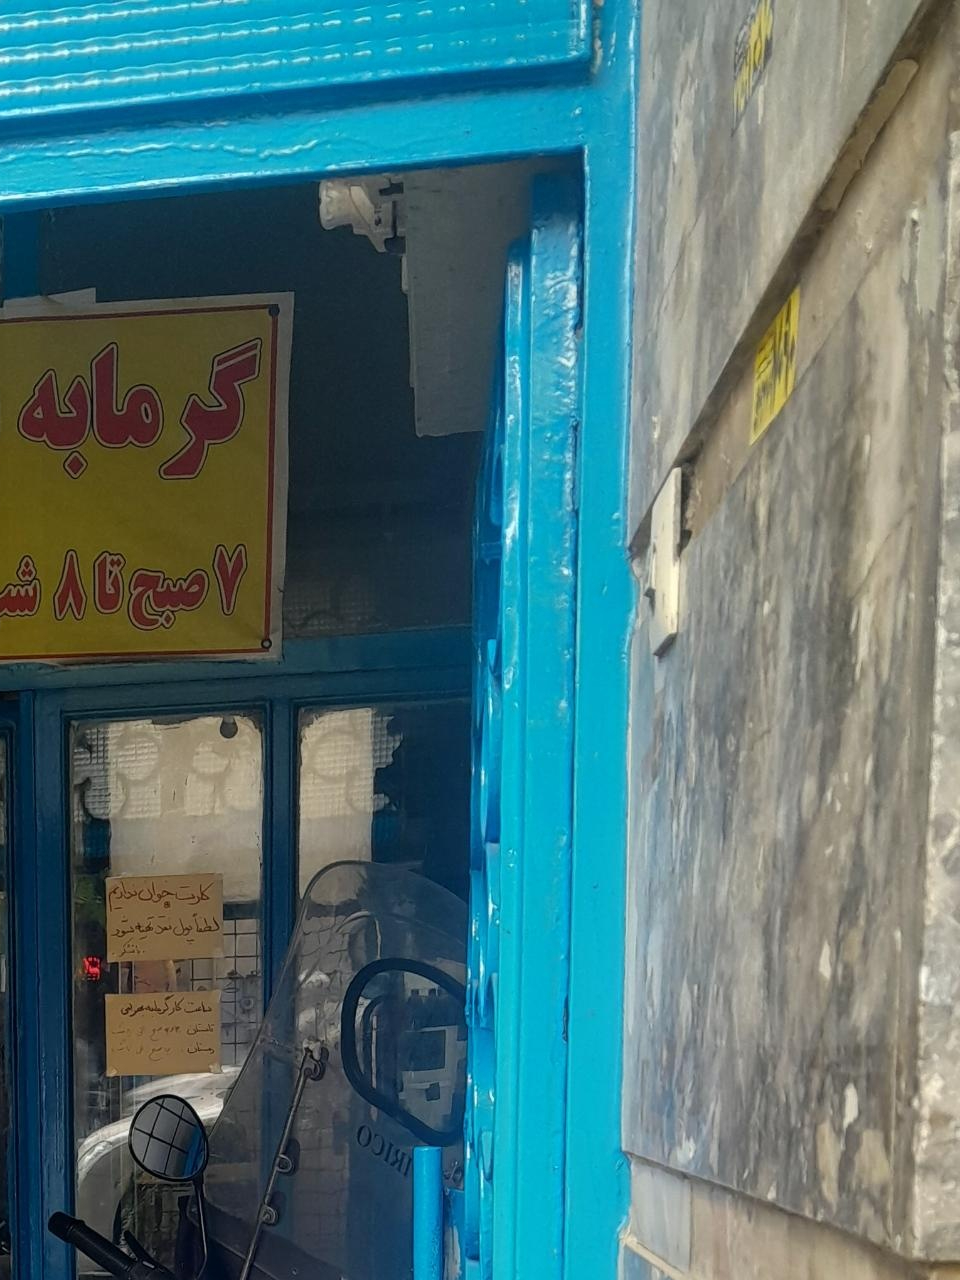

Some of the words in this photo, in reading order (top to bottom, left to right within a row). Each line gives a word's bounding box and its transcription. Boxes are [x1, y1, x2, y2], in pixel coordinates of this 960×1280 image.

[17, 338, 262, 479] گرمابه
[54, 549, 87, 620] ۸
[93, 551, 126, 614] تا
[128, 556, 209, 631] صبح
[213, 544, 247, 615] ۷
[108, 881, 137, 912] نداریم
[111, 914, 135, 938] شود
[173, 917, 195, 944] پول
[184, 1000, 213, 1014] ساعت
